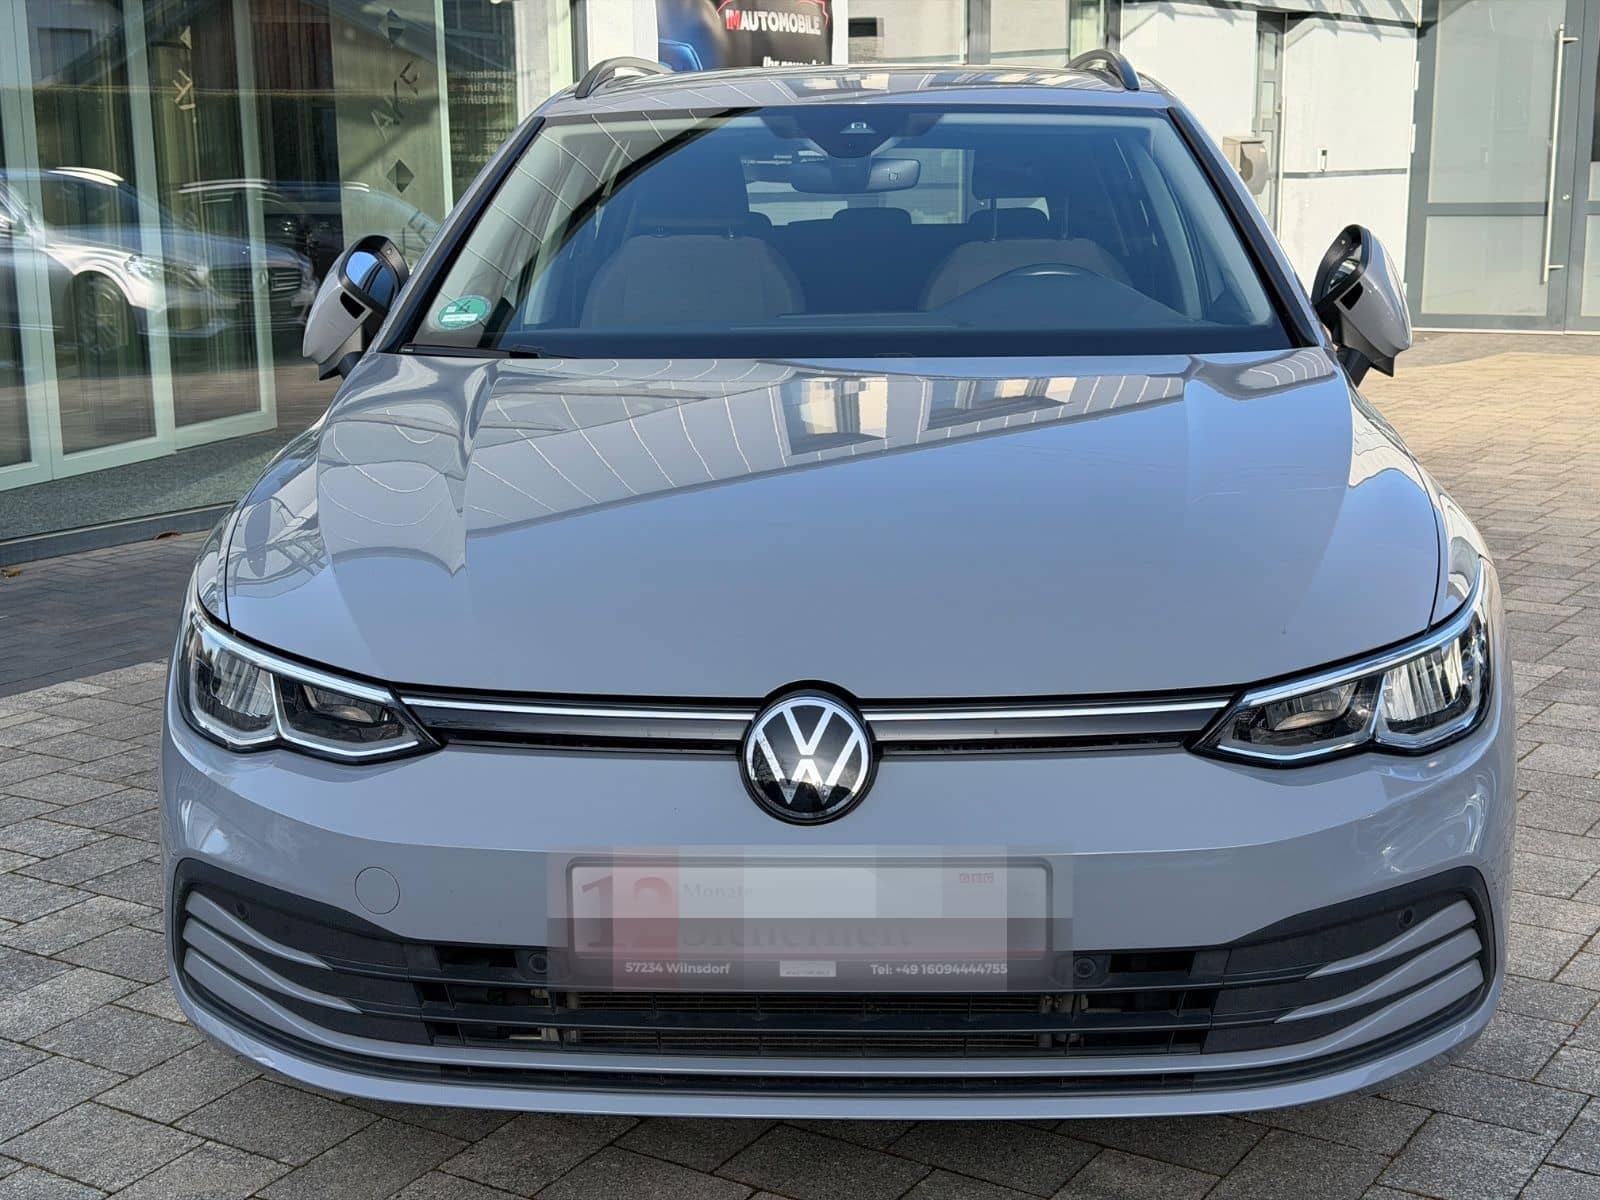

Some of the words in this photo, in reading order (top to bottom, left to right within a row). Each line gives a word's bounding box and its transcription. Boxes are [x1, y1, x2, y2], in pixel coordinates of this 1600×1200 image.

[625, 962, 663, 974] 57234
[666, 962, 731, 975] Wilnsdorf
[870, 963, 893, 976] Tel:
[895, 963, 919, 976] +49
[921, 963, 1008, 976] 16094444755
